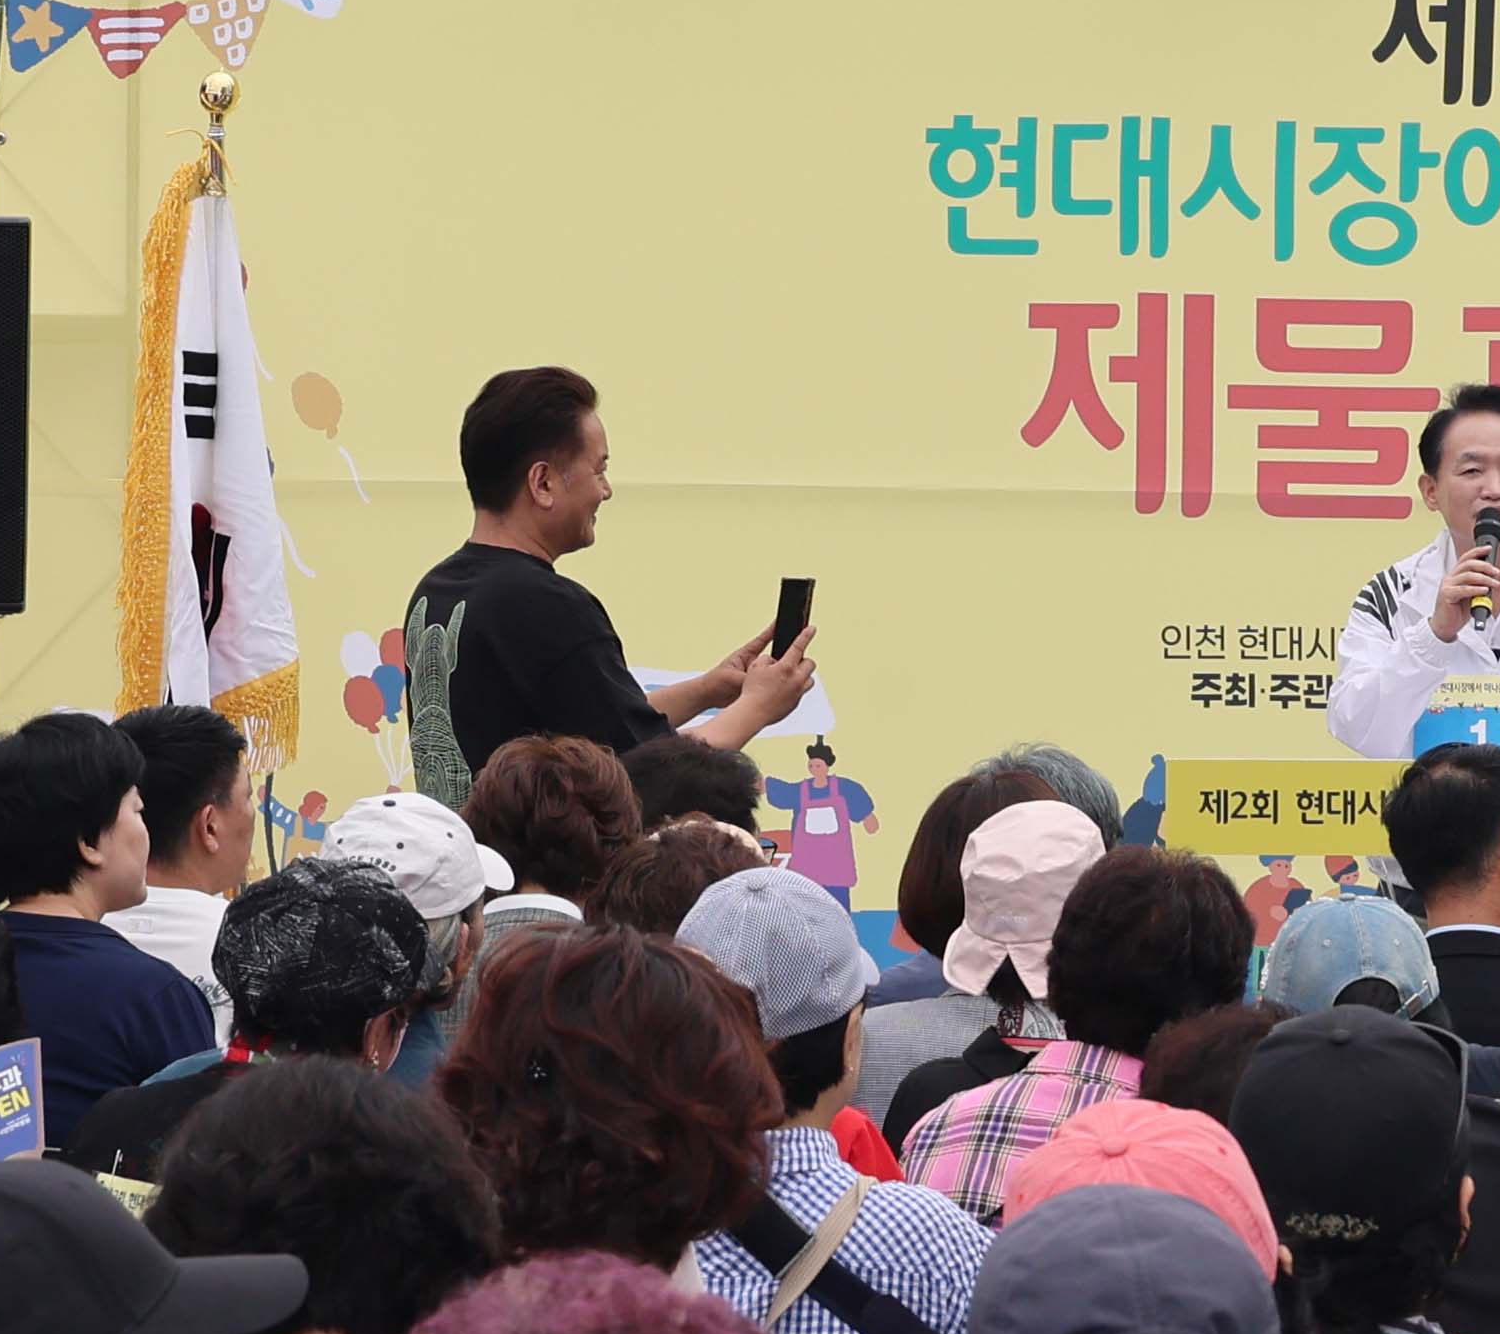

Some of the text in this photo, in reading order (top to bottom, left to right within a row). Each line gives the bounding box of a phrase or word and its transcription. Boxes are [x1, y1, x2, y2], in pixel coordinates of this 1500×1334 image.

[1160, 624, 1227, 661] 인천
[1237, 624, 1343, 662] 현대시
[1469, 718, 1488, 746] 1
[1198, 788, 1281, 826] 제2회
[1295, 789, 1388, 827] 현대시
